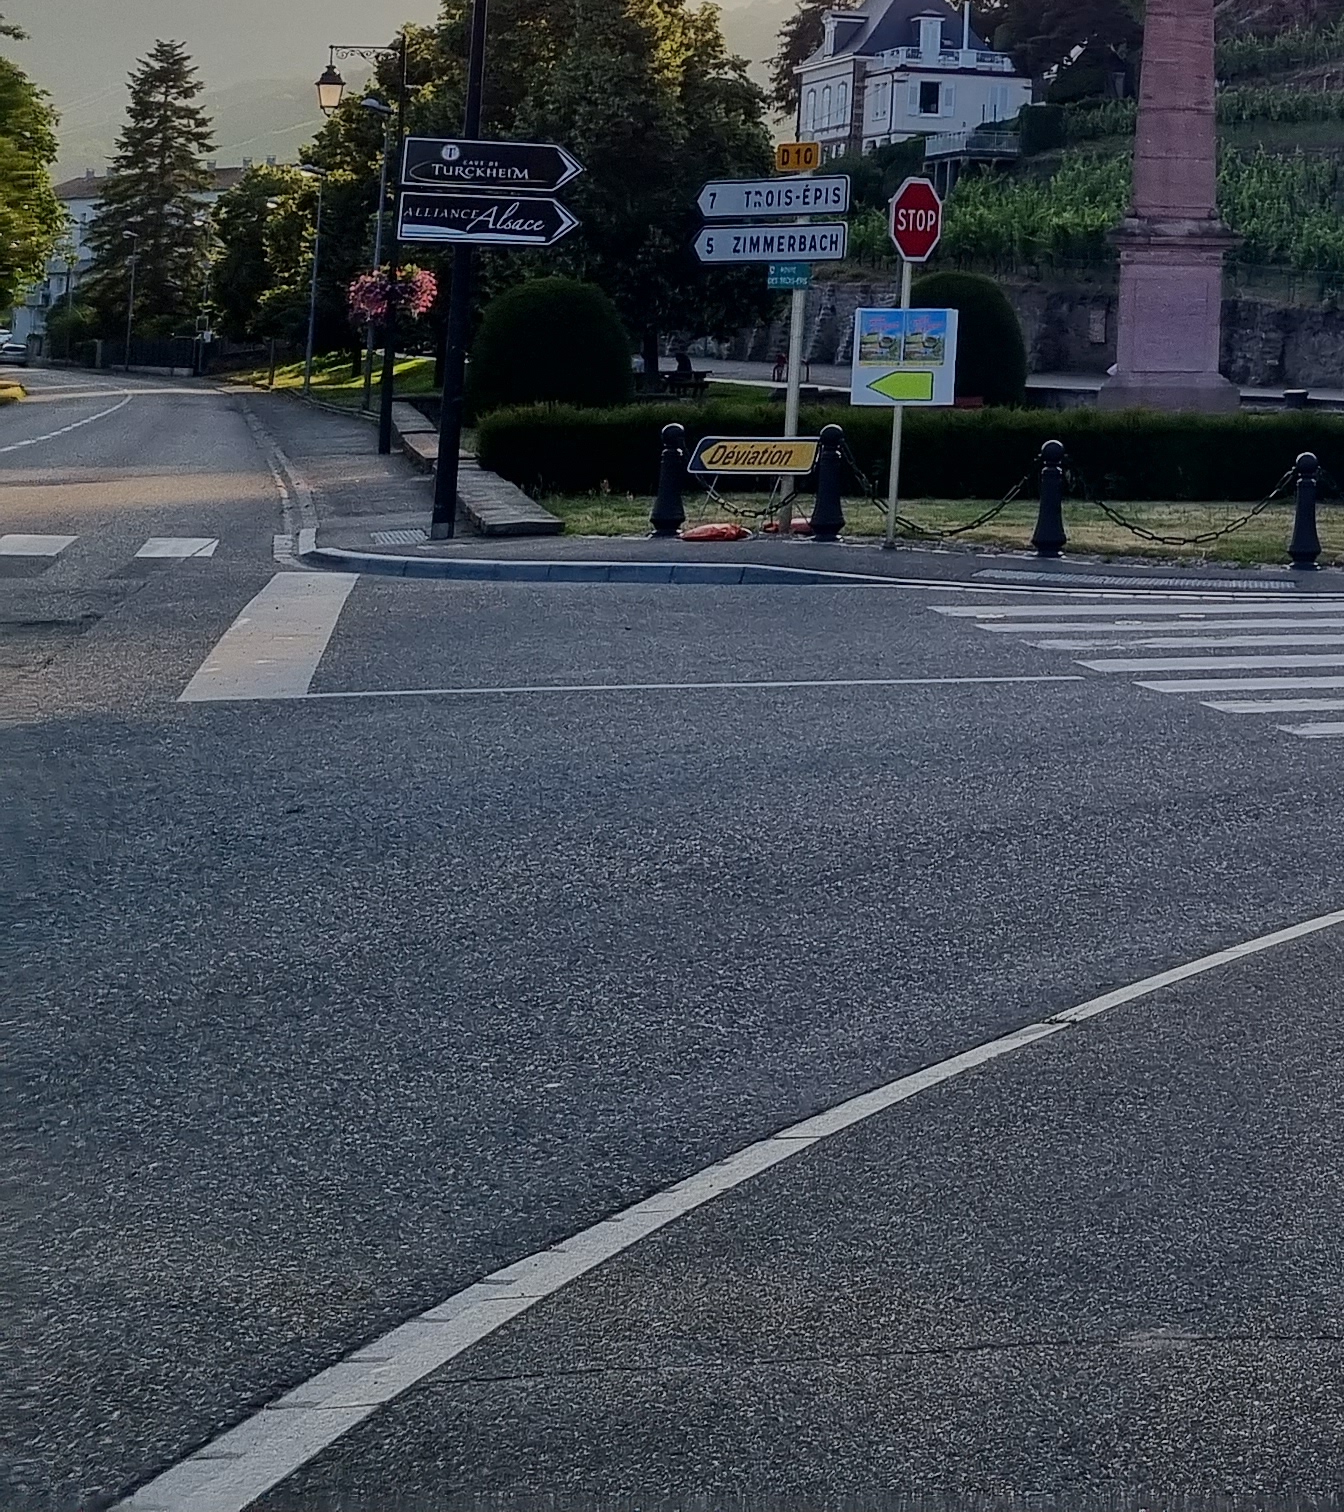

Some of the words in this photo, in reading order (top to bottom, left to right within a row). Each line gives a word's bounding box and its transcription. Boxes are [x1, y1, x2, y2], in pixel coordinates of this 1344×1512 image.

[781, 148, 790, 166] D
[795, 147, 813, 165] 10
[431, 163, 529, 180] TURCKHEIM
[709, 192, 717, 209] 7
[744, 184, 841, 208] TROIS-ÉPIS
[403, 207, 480, 219] ALLIANCE
[465, 201, 545, 231] Alsace
[897, 208, 936, 231] STOP
[705, 237, 714, 254] 5
[732, 233, 839, 254] ZIMMERBACH
[707, 444, 793, 466] Déviation
